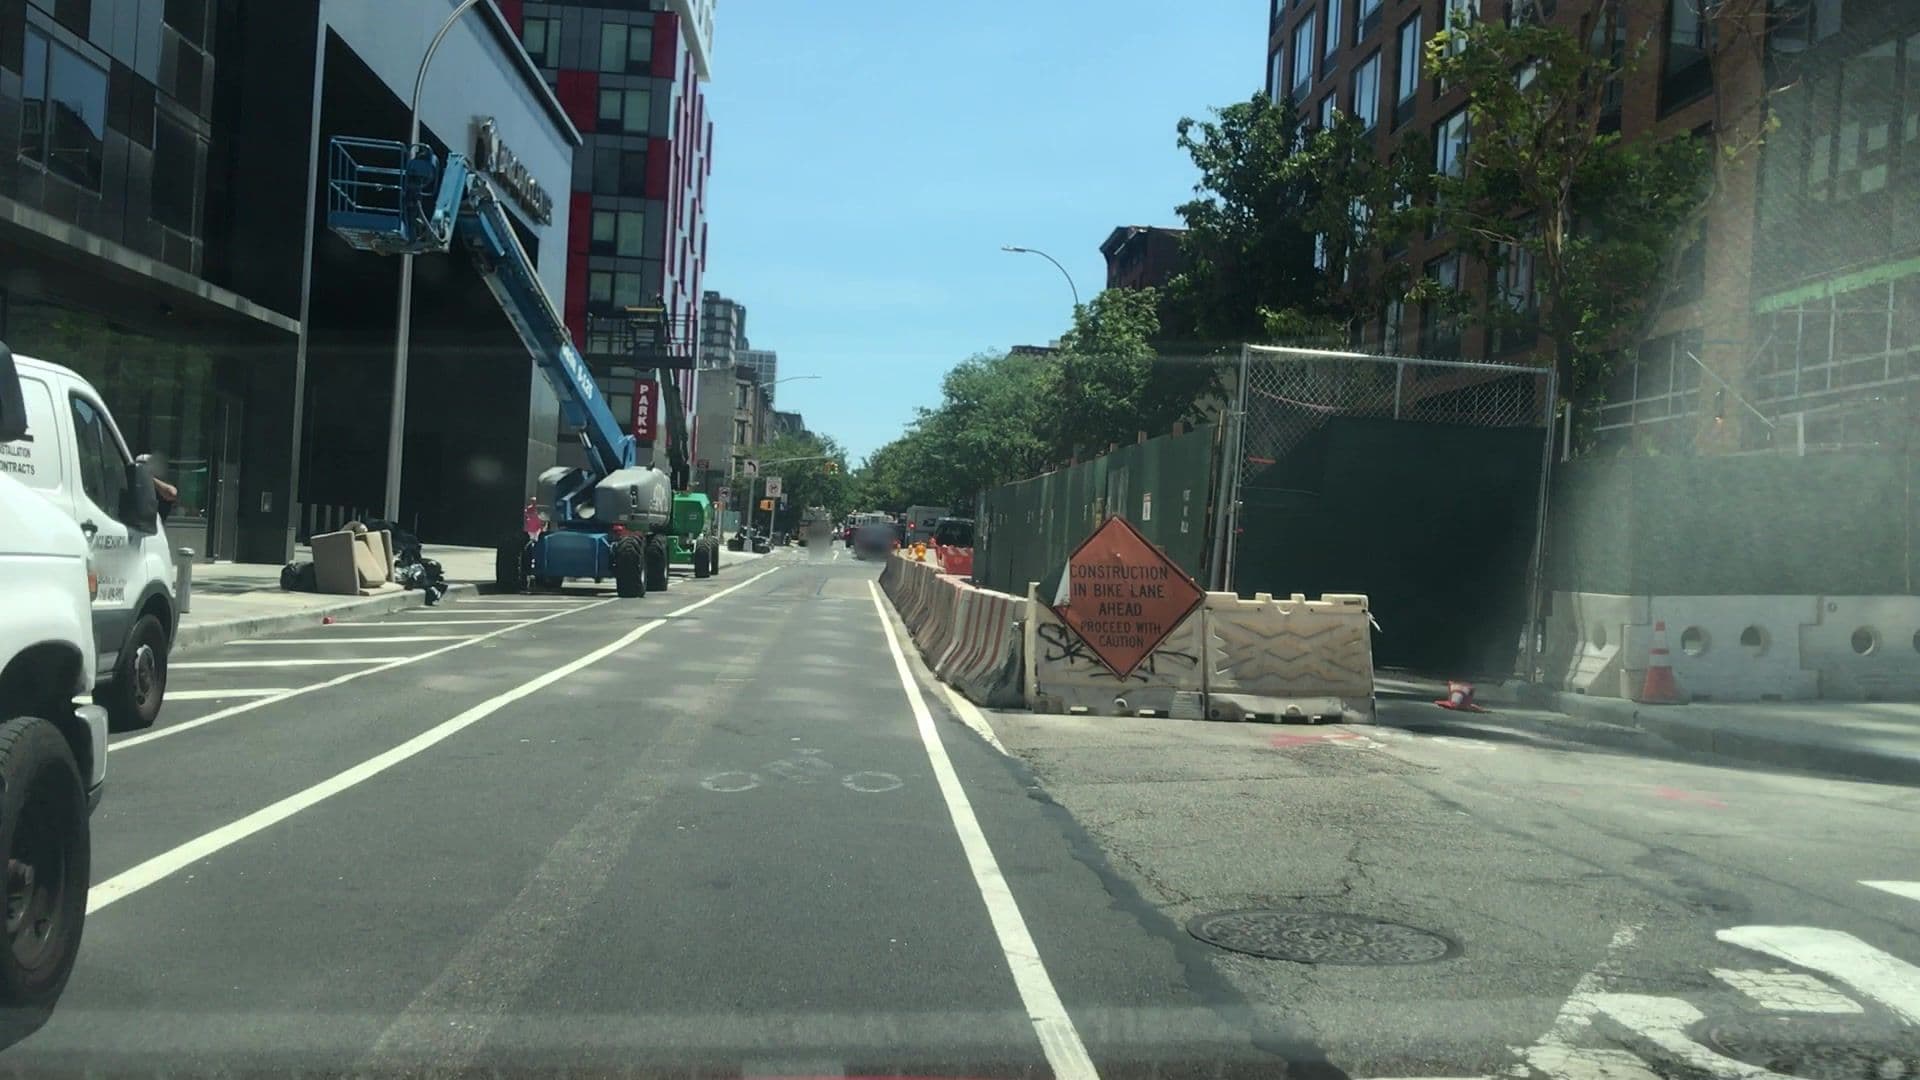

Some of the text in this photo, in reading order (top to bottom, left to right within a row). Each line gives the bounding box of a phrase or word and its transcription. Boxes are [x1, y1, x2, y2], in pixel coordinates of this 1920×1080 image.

[638, 384, 649, 427] PARK
[1070, 565, 1168, 580] CONSTRUCTION
[1073, 583, 1165, 598] IN BIKE LANE
[1099, 602, 1143, 617] AHEAD
[1081, 621, 1161, 635] PROCEED WITH
[1098, 635, 1145, 649] CAUTION
